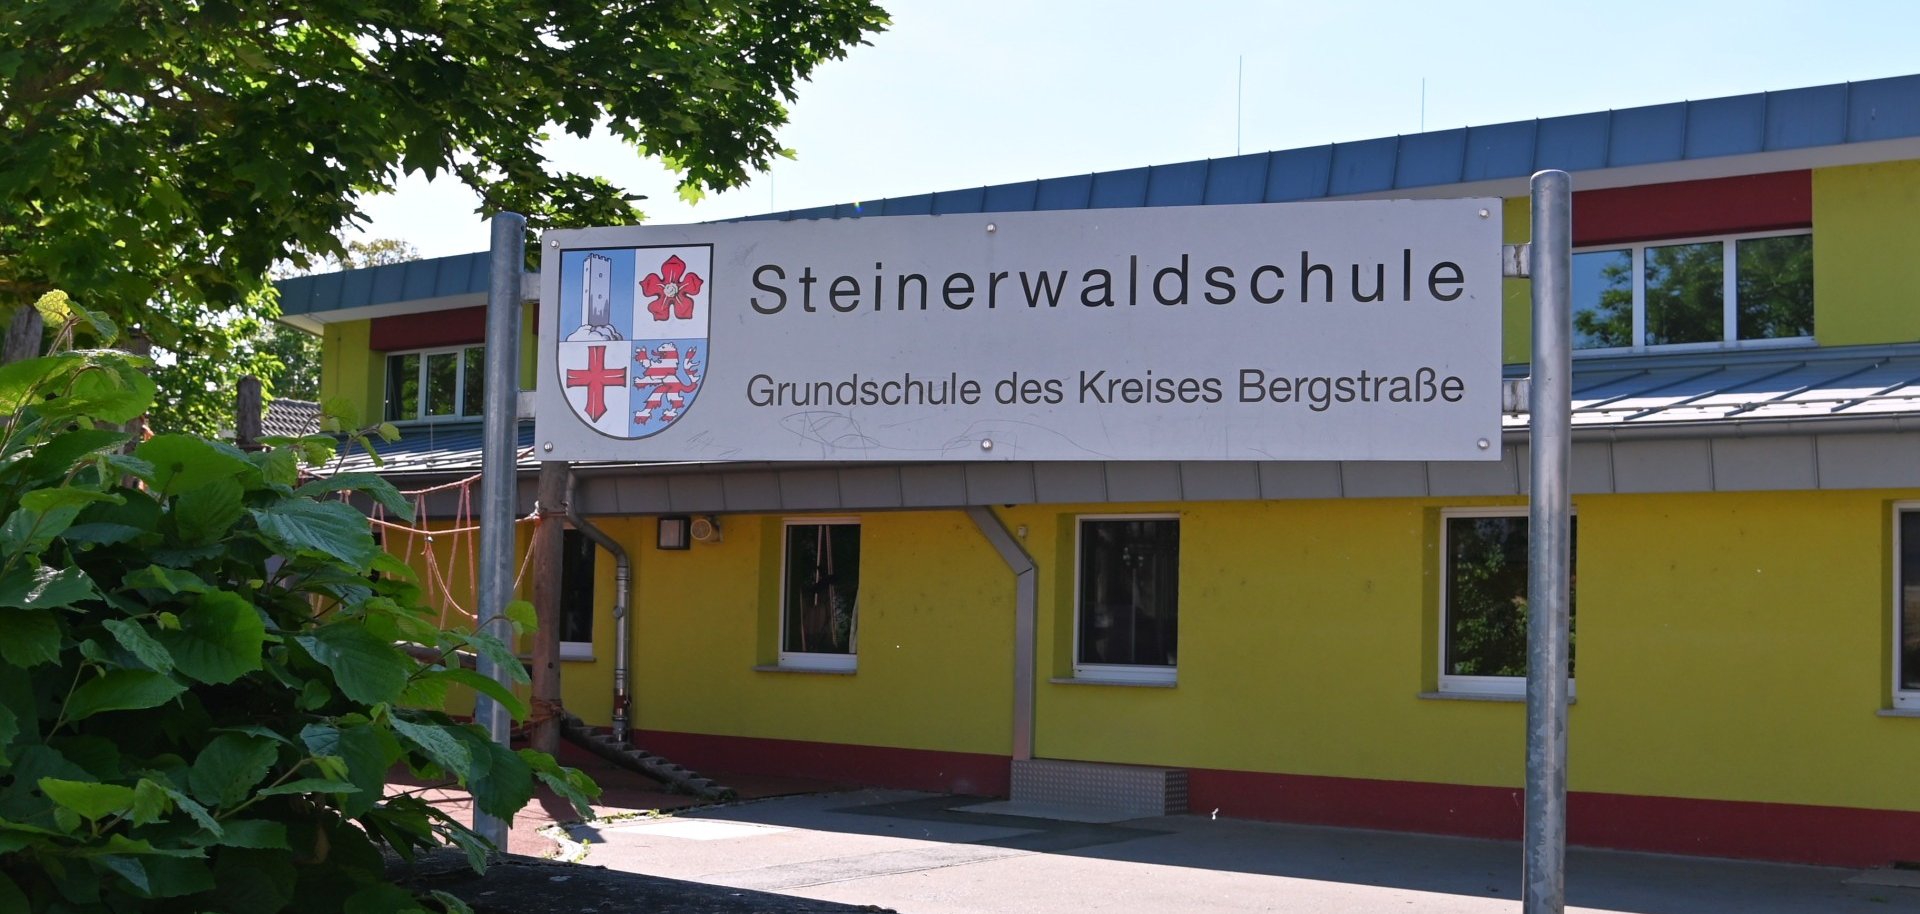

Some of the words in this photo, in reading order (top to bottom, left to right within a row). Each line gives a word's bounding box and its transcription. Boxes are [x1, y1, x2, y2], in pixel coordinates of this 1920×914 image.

[749, 248, 1466, 316] Steinerwaldschule
[746, 372, 982, 408] Grundschule
[994, 370, 1064, 405] des
[1078, 368, 1223, 404] Kreises
[1239, 366, 1465, 412] Bergstraße
